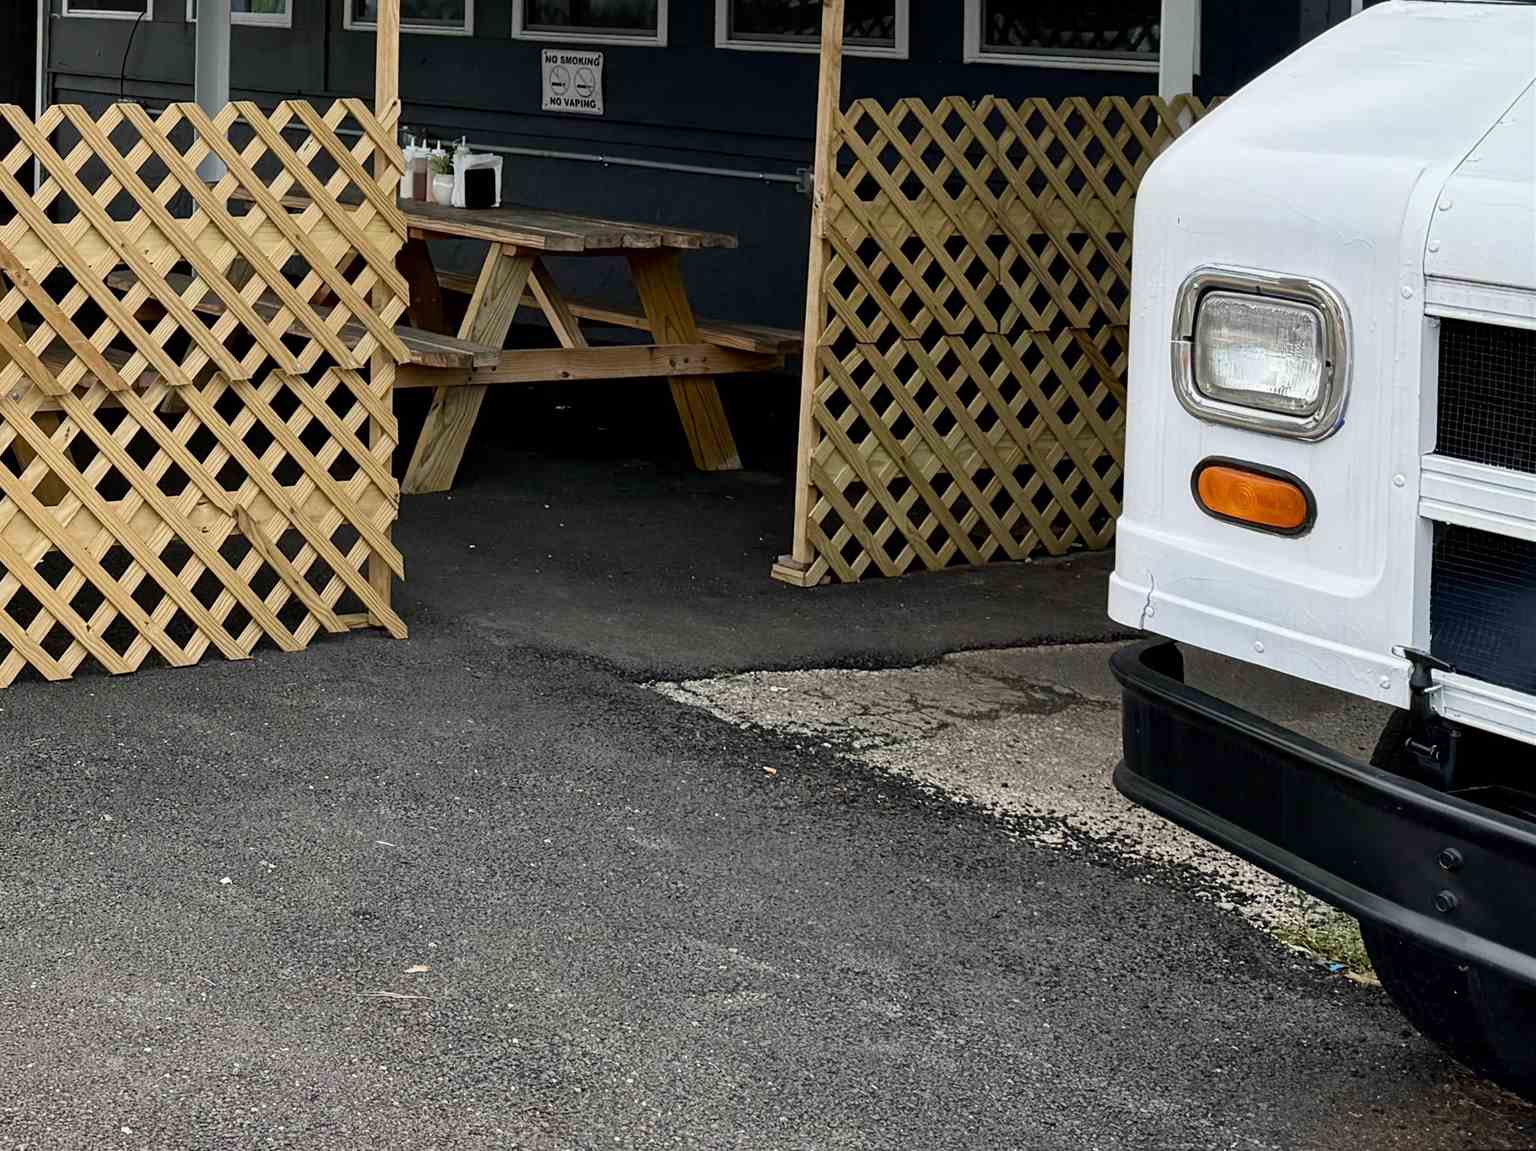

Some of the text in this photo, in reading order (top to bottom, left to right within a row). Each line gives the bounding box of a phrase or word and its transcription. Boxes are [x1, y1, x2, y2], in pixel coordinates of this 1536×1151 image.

[545, 55, 600, 66] NO SMOKING
[550, 97, 596, 108] NO VAPING
